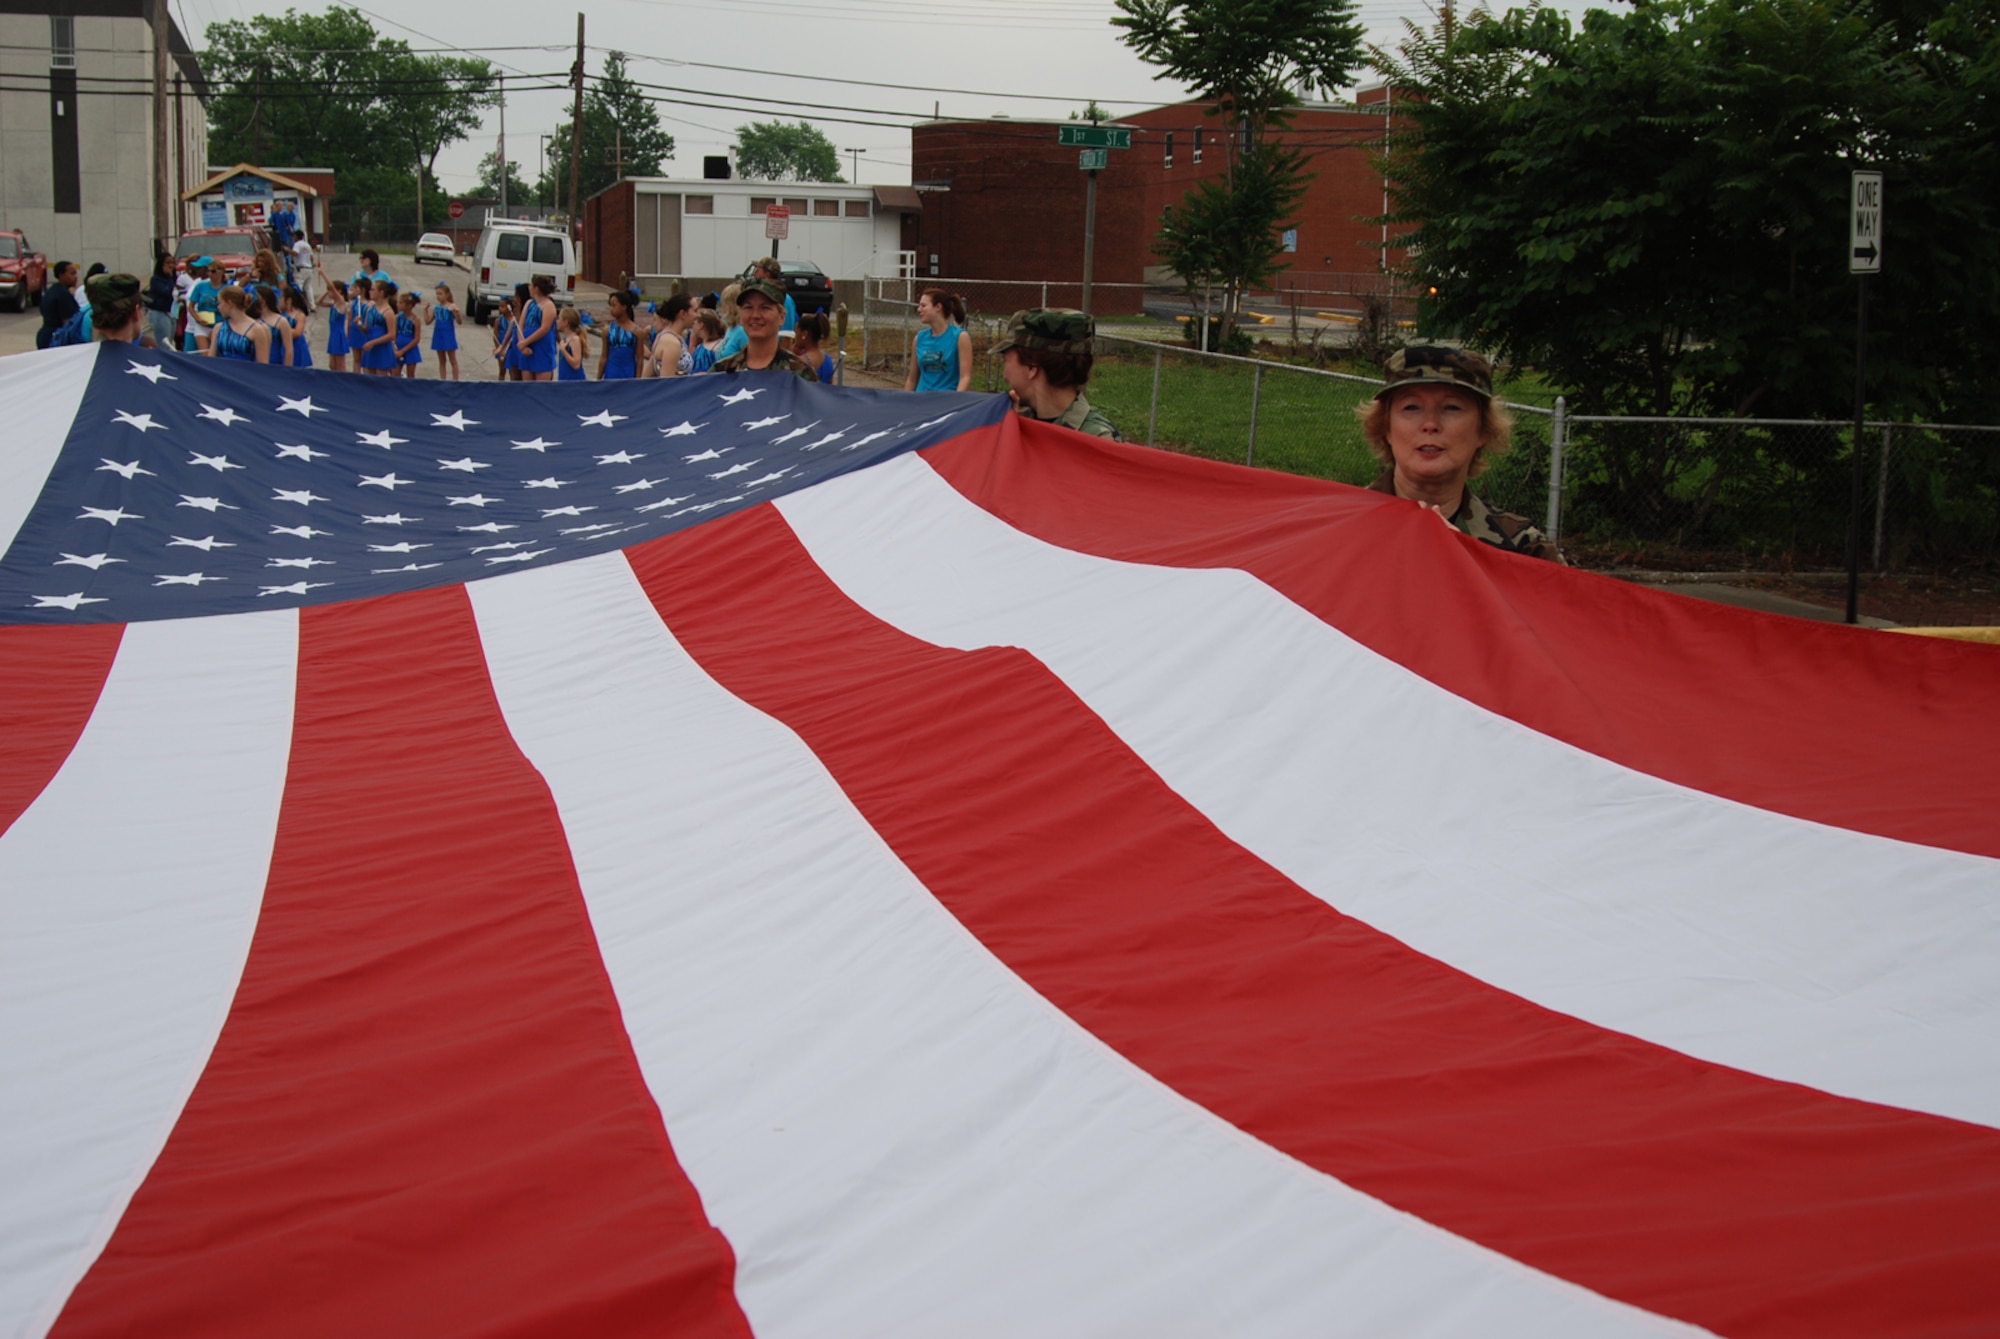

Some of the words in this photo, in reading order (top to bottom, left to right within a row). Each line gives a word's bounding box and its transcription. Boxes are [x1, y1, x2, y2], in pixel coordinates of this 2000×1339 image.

[1857, 181, 1879, 207] ONE
[449, 207, 463, 215] STOP
[1856, 211, 1878, 237] WAY
